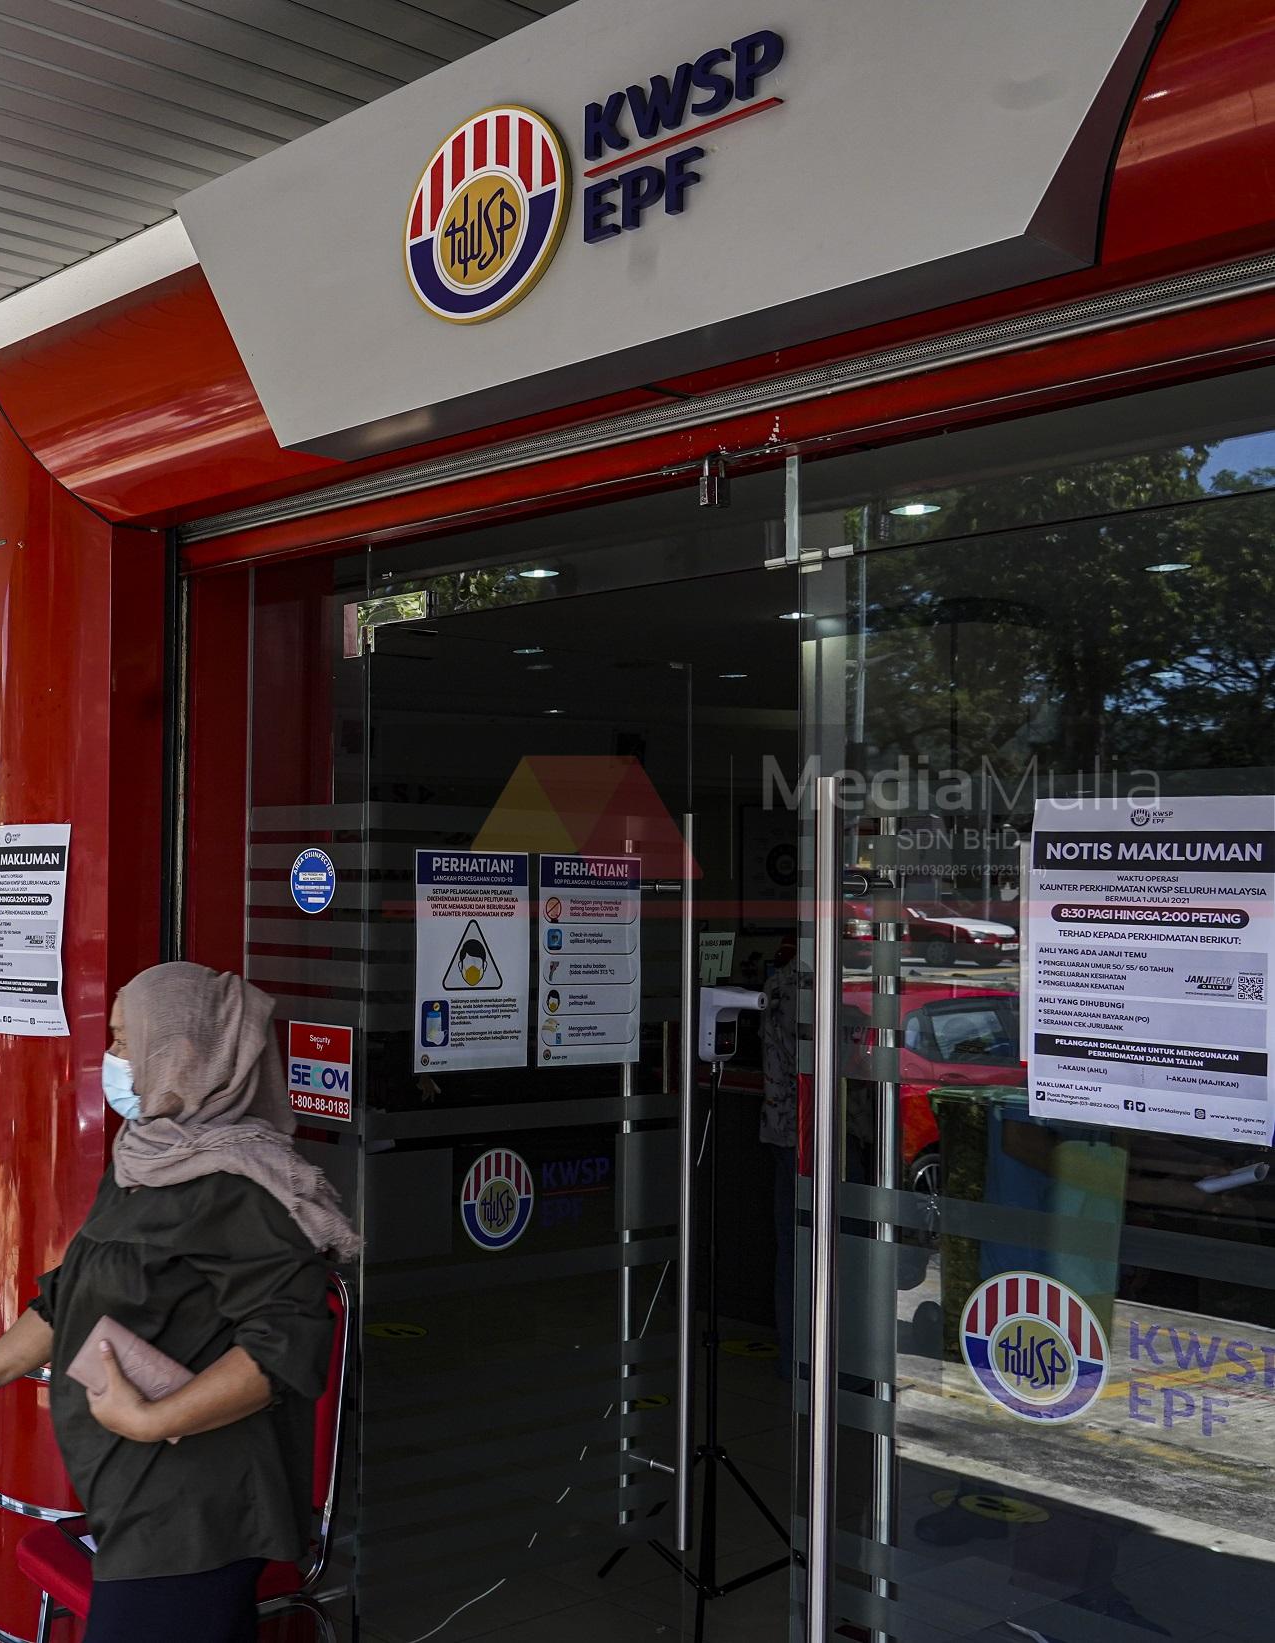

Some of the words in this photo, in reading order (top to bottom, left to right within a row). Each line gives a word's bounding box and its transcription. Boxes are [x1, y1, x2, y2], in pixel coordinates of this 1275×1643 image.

[584, 29, 784, 161] KWSP
[583, 146, 705, 244] EPF
[1046, 842, 1112, 860] NOTIS
[1117, 843, 1262, 861] MAKLUMAN
[0, 853, 60, 865] MAKLUMAN
[432, 857, 514, 873] PERHATIAN!
[554, 861, 629, 878] PERHATIAN!
[1039, 883, 1078, 891] KAUNTER
[1079, 884, 1145, 893] PERKHIDMATAN
[1147, 886, 1173, 894] KWSP
[1174, 886, 1216, 895] SELURUH
[1217, 887, 1267, 896] MALAYSIA
[1105, 895, 1141, 903] BERMULA
[1146, 896, 1169, 904] JULAI
[1060, 908, 1086, 918] 8:30
[1087, 909, 1113, 920] PAGI
[1114, 910, 1160, 921] HINGGA
[1161, 911, 1190, 922] 2:00
[1191, 912, 1241, 924] PETANG
[1058, 929, 1092, 938] TERHAD
[1092, 931, 1127, 940] KEPADA
[1127, 933, 1198, 943] PERKHIDMATAN
[1199, 935, 1242, 945] BERIKUT:
[1038, 946, 1057, 954] AHLI
[1058, 947, 1079, 955] YANG
[1124, 951, 1147, 959] TEMU
[1043, 960, 1090, 968] PENGELUARAN
[1043, 970, 1090, 978] PENGELUARAN
[1090, 973, 1127, 981] KESIHATAN
[1184, 975, 1235, 985] JANJITEMU
[1043, 980, 1090, 989] PENGELUARAN
[1090, 983, 1125, 991] KEMATIAN
[1057, 998, 1079, 1006] YANG
[1079, 1000, 1125, 1009] DIHUBUNGI
[1043, 1008, 1073, 1016] SERAHAN
[1073, 1011, 1102, 1019] ARAHAN
[1102, 1013, 1134, 1022] BAYARAN
[1134, 1016, 1150, 1024] (PO)
[1043, 1018, 1073, 1027] SERAHAN
[1087, 1022, 1124, 1031] JURUBANK
[309, 1034, 331, 1046] Security
[316, 1043, 324, 1052] by
[1055, 1038, 1099, 1048] PELANGGAN
[1099, 1042, 1147, 1053] DIGALAKKAN
[1147, 1046, 1175, 1056] UNTUK
[1176, 1049, 1239, 1061] MENGGUNAKAN
[1087, 1050, 1145, 1062] PERKHIDMATAN
[1145, 1055, 1175, 1064] DALAM
[1175, 1058, 1204, 1067] TALIAN
[1086, 1066, 1108, 1075] (AHLI)
[291, 1063, 349, 1092] SECOM
[1198, 1078, 1239, 1089] (MAJIKAN)
[1036, 1081, 1074, 1090] MAKLUMAT
[1074, 1084, 1102, 1092] LANJUT
[290, 1093, 349, 1115] 1-800-88-0183
[541, 1157, 611, 1188] KWSP
[1128, 1381, 1230, 1437] EPF
